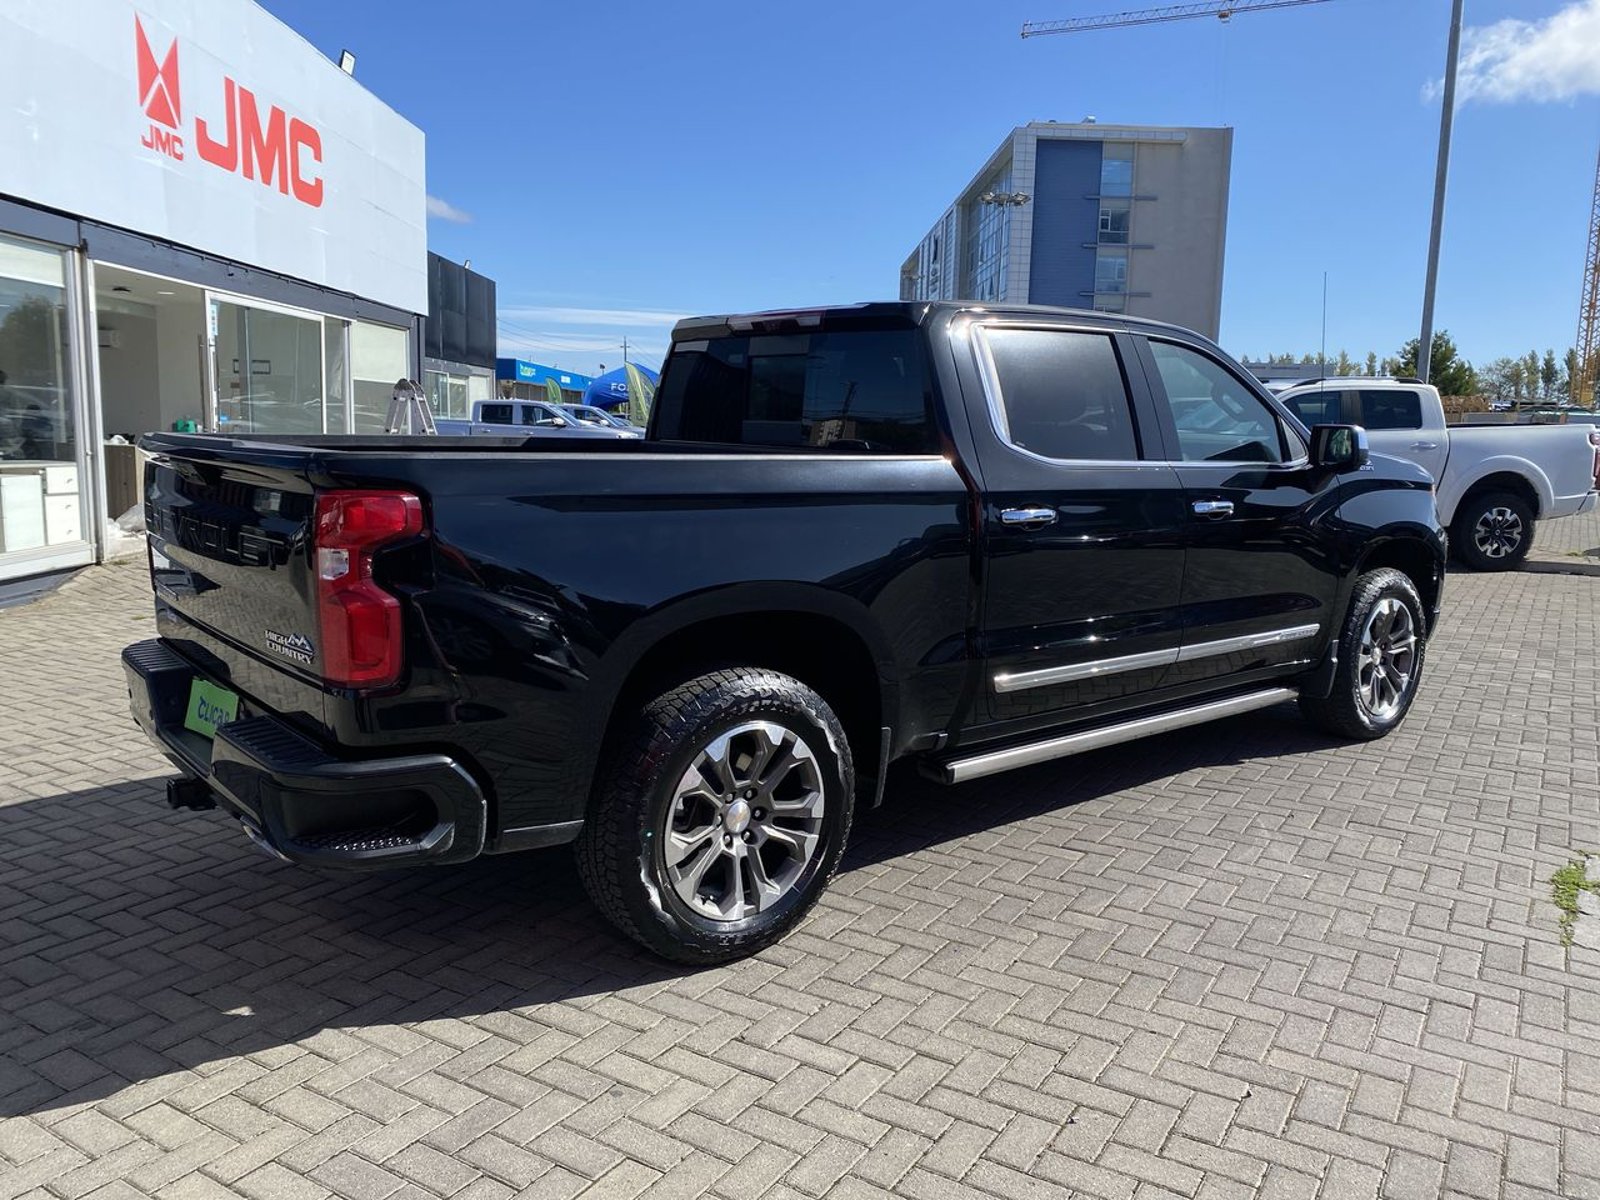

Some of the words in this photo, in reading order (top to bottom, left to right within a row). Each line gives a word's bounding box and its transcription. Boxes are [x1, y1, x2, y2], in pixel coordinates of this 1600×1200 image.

[141, 124, 184, 161] JMC
[195, 75, 323, 207] JMC
[610, 382, 629, 392] FO
[264, 629, 288, 646] HIGH
[266, 639, 312, 665] COUNTRY
